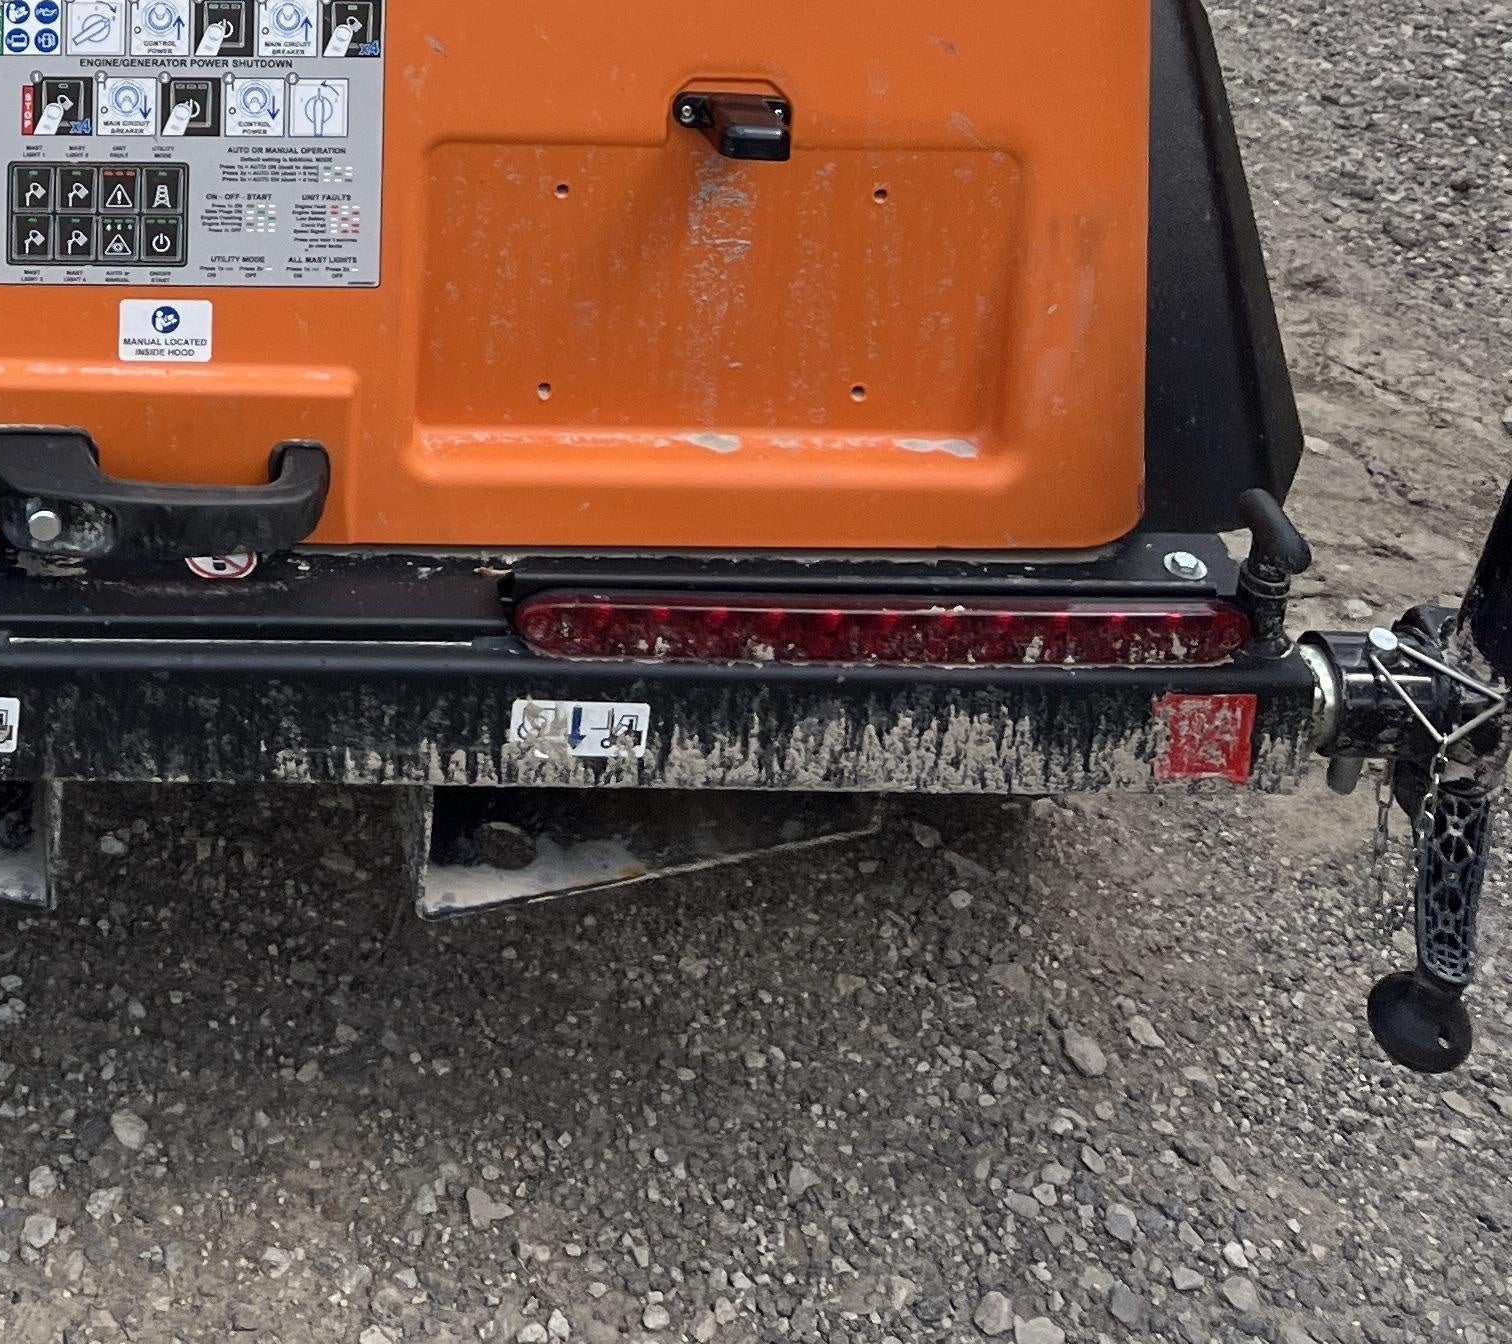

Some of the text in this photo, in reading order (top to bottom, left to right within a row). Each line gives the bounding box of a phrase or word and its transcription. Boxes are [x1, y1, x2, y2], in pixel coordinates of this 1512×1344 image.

[79, 58, 293, 69] ENGINE/GENERATOR POWER SHUTDOWN
[24, 92, 33, 128] STOP
[227, 146, 250, 154] AUTO
[123, 338, 207, 346] MANUAL LOCATED
[134, 348, 195, 357] INSIDE HOOD
